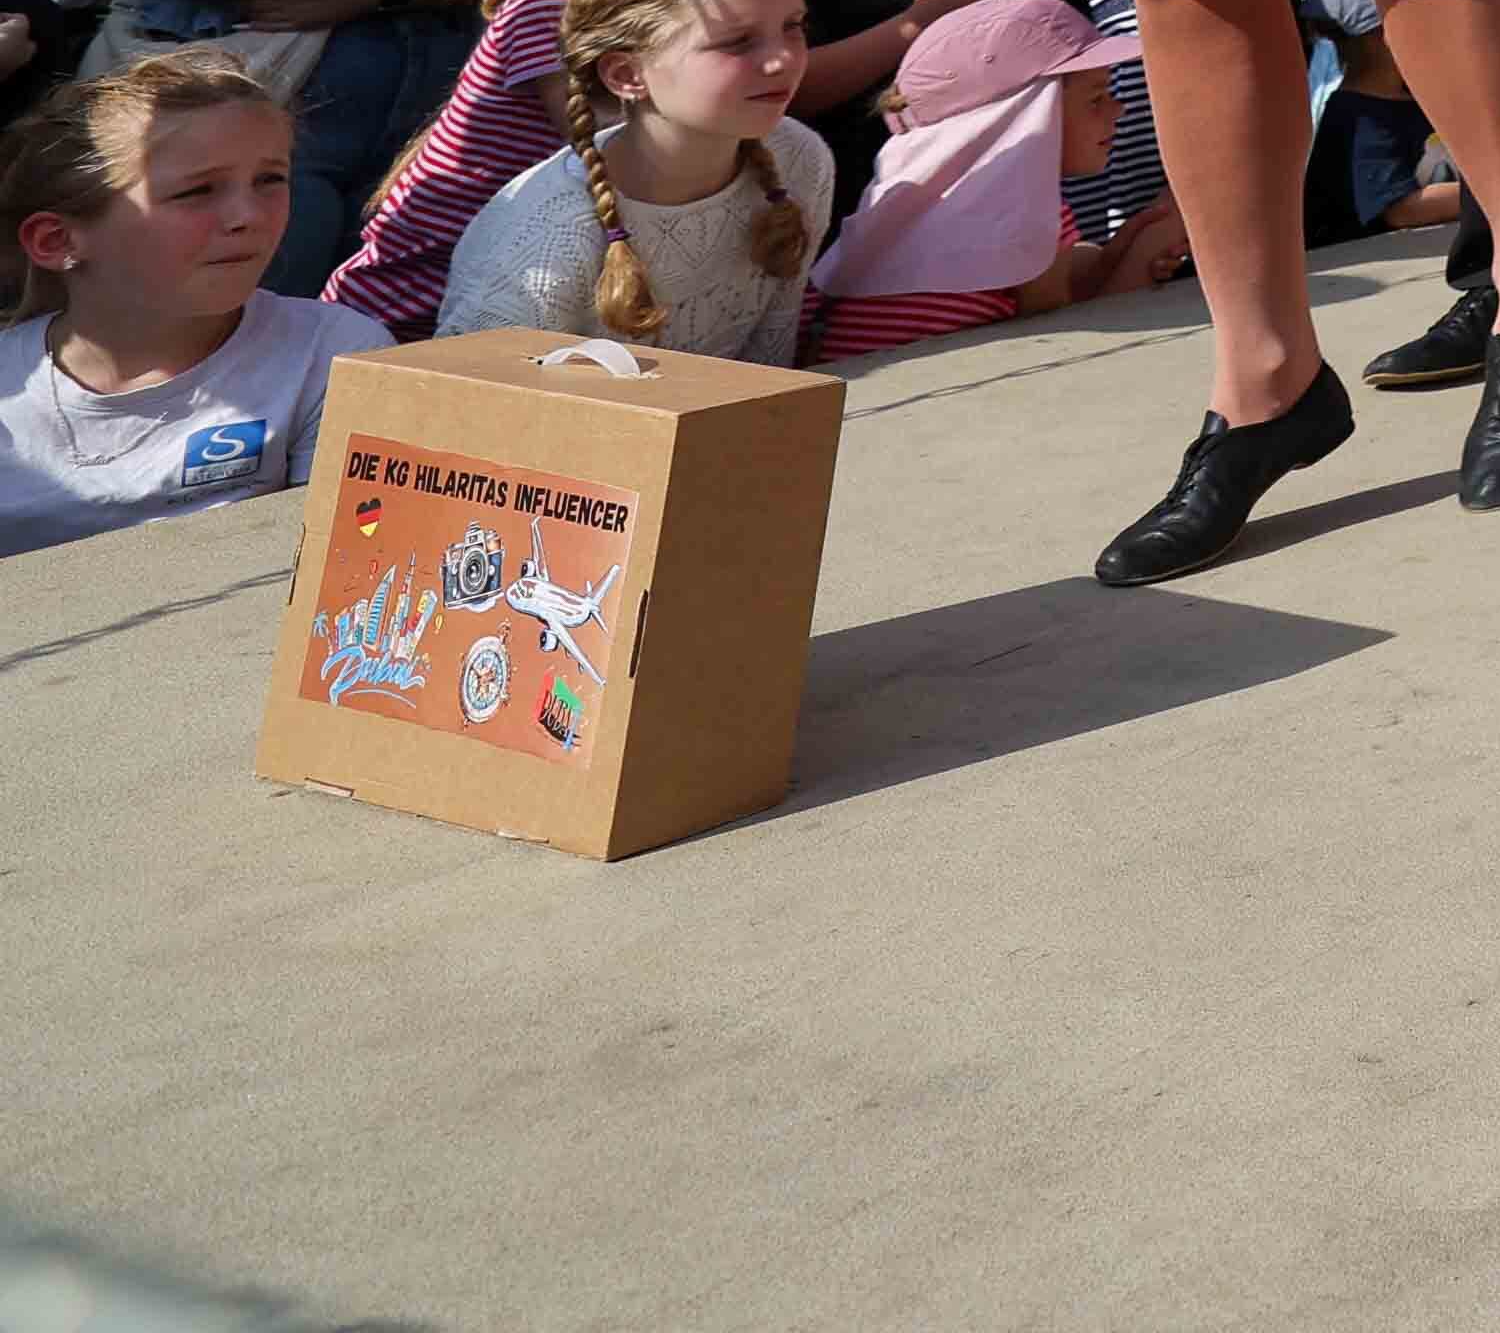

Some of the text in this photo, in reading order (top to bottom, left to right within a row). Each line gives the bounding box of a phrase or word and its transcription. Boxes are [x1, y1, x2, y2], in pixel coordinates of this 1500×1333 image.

[348, 451, 629, 533] DIE KG HILARITAS INFLUENCER
